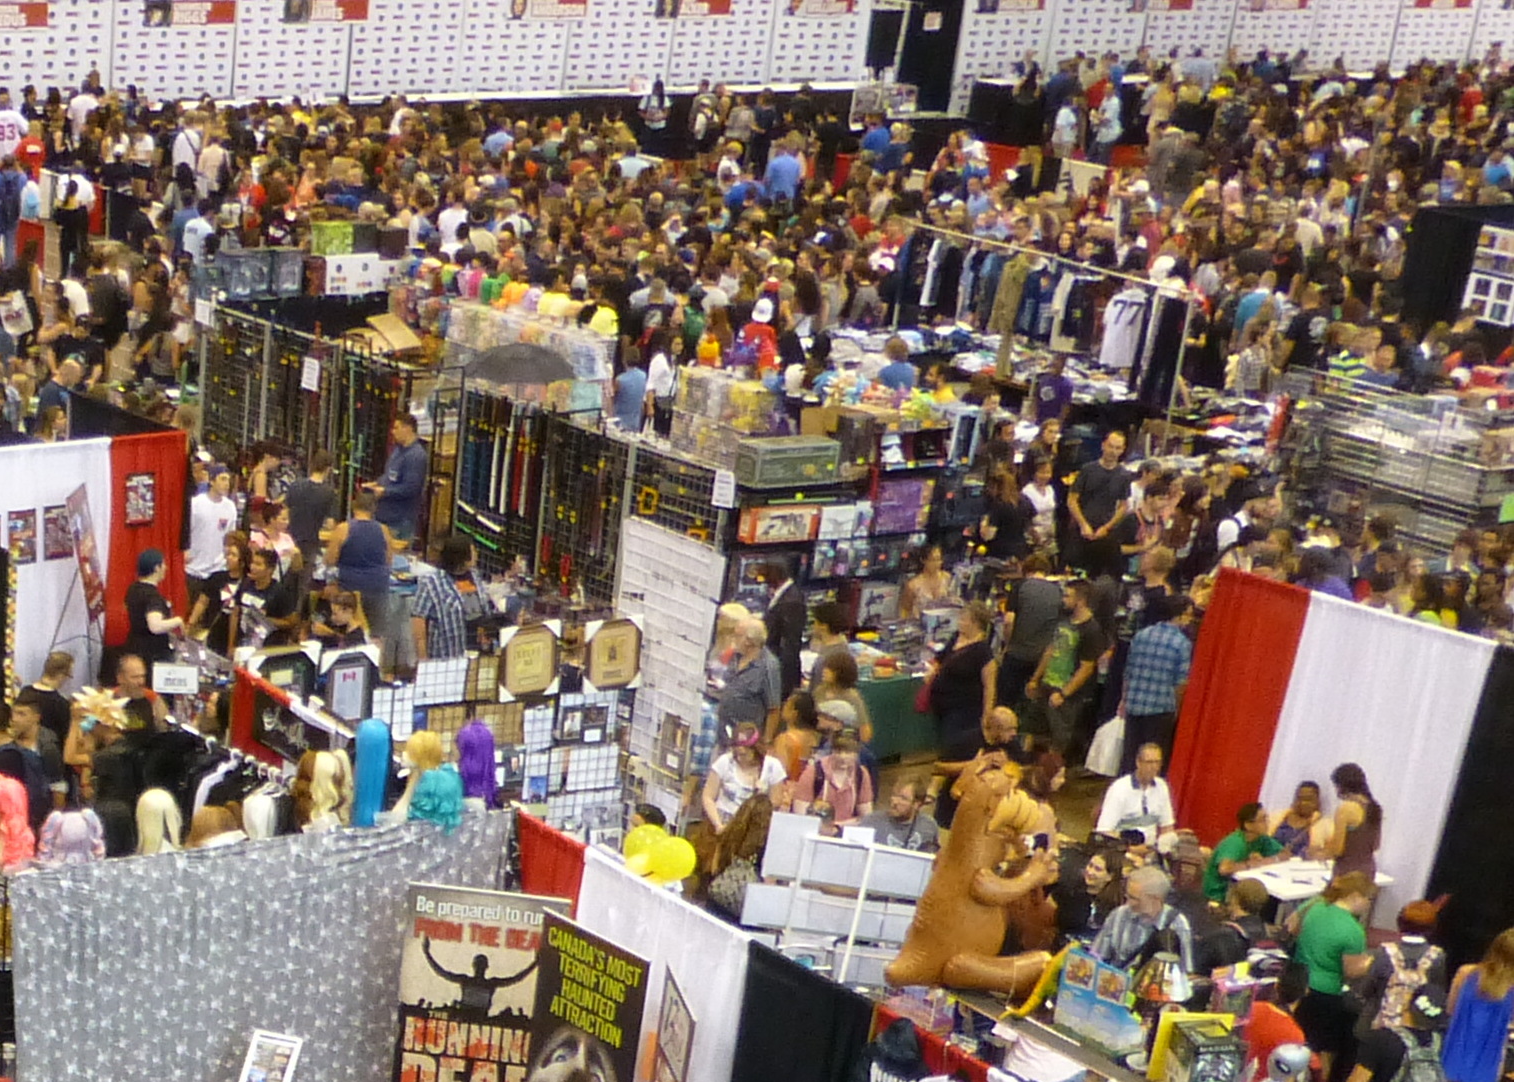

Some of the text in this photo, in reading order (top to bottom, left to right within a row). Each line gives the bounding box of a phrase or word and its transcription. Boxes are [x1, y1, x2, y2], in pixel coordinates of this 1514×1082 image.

[1113, 298, 1146, 326] 77
[416, 895, 435, 913] Be
[438, 901, 501, 919] prepared
[505, 905, 519, 921] to
[414, 916, 542, 952] FROM THE DEA
[548, 926, 642, 988] CANADA'S MOST
[559, 951, 626, 1004] TERRIFYING
[561, 977, 616, 1022] HAUNTED
[403, 1015, 532, 1064] RUNNIN
[549, 994, 623, 1049] ATTRACTION
